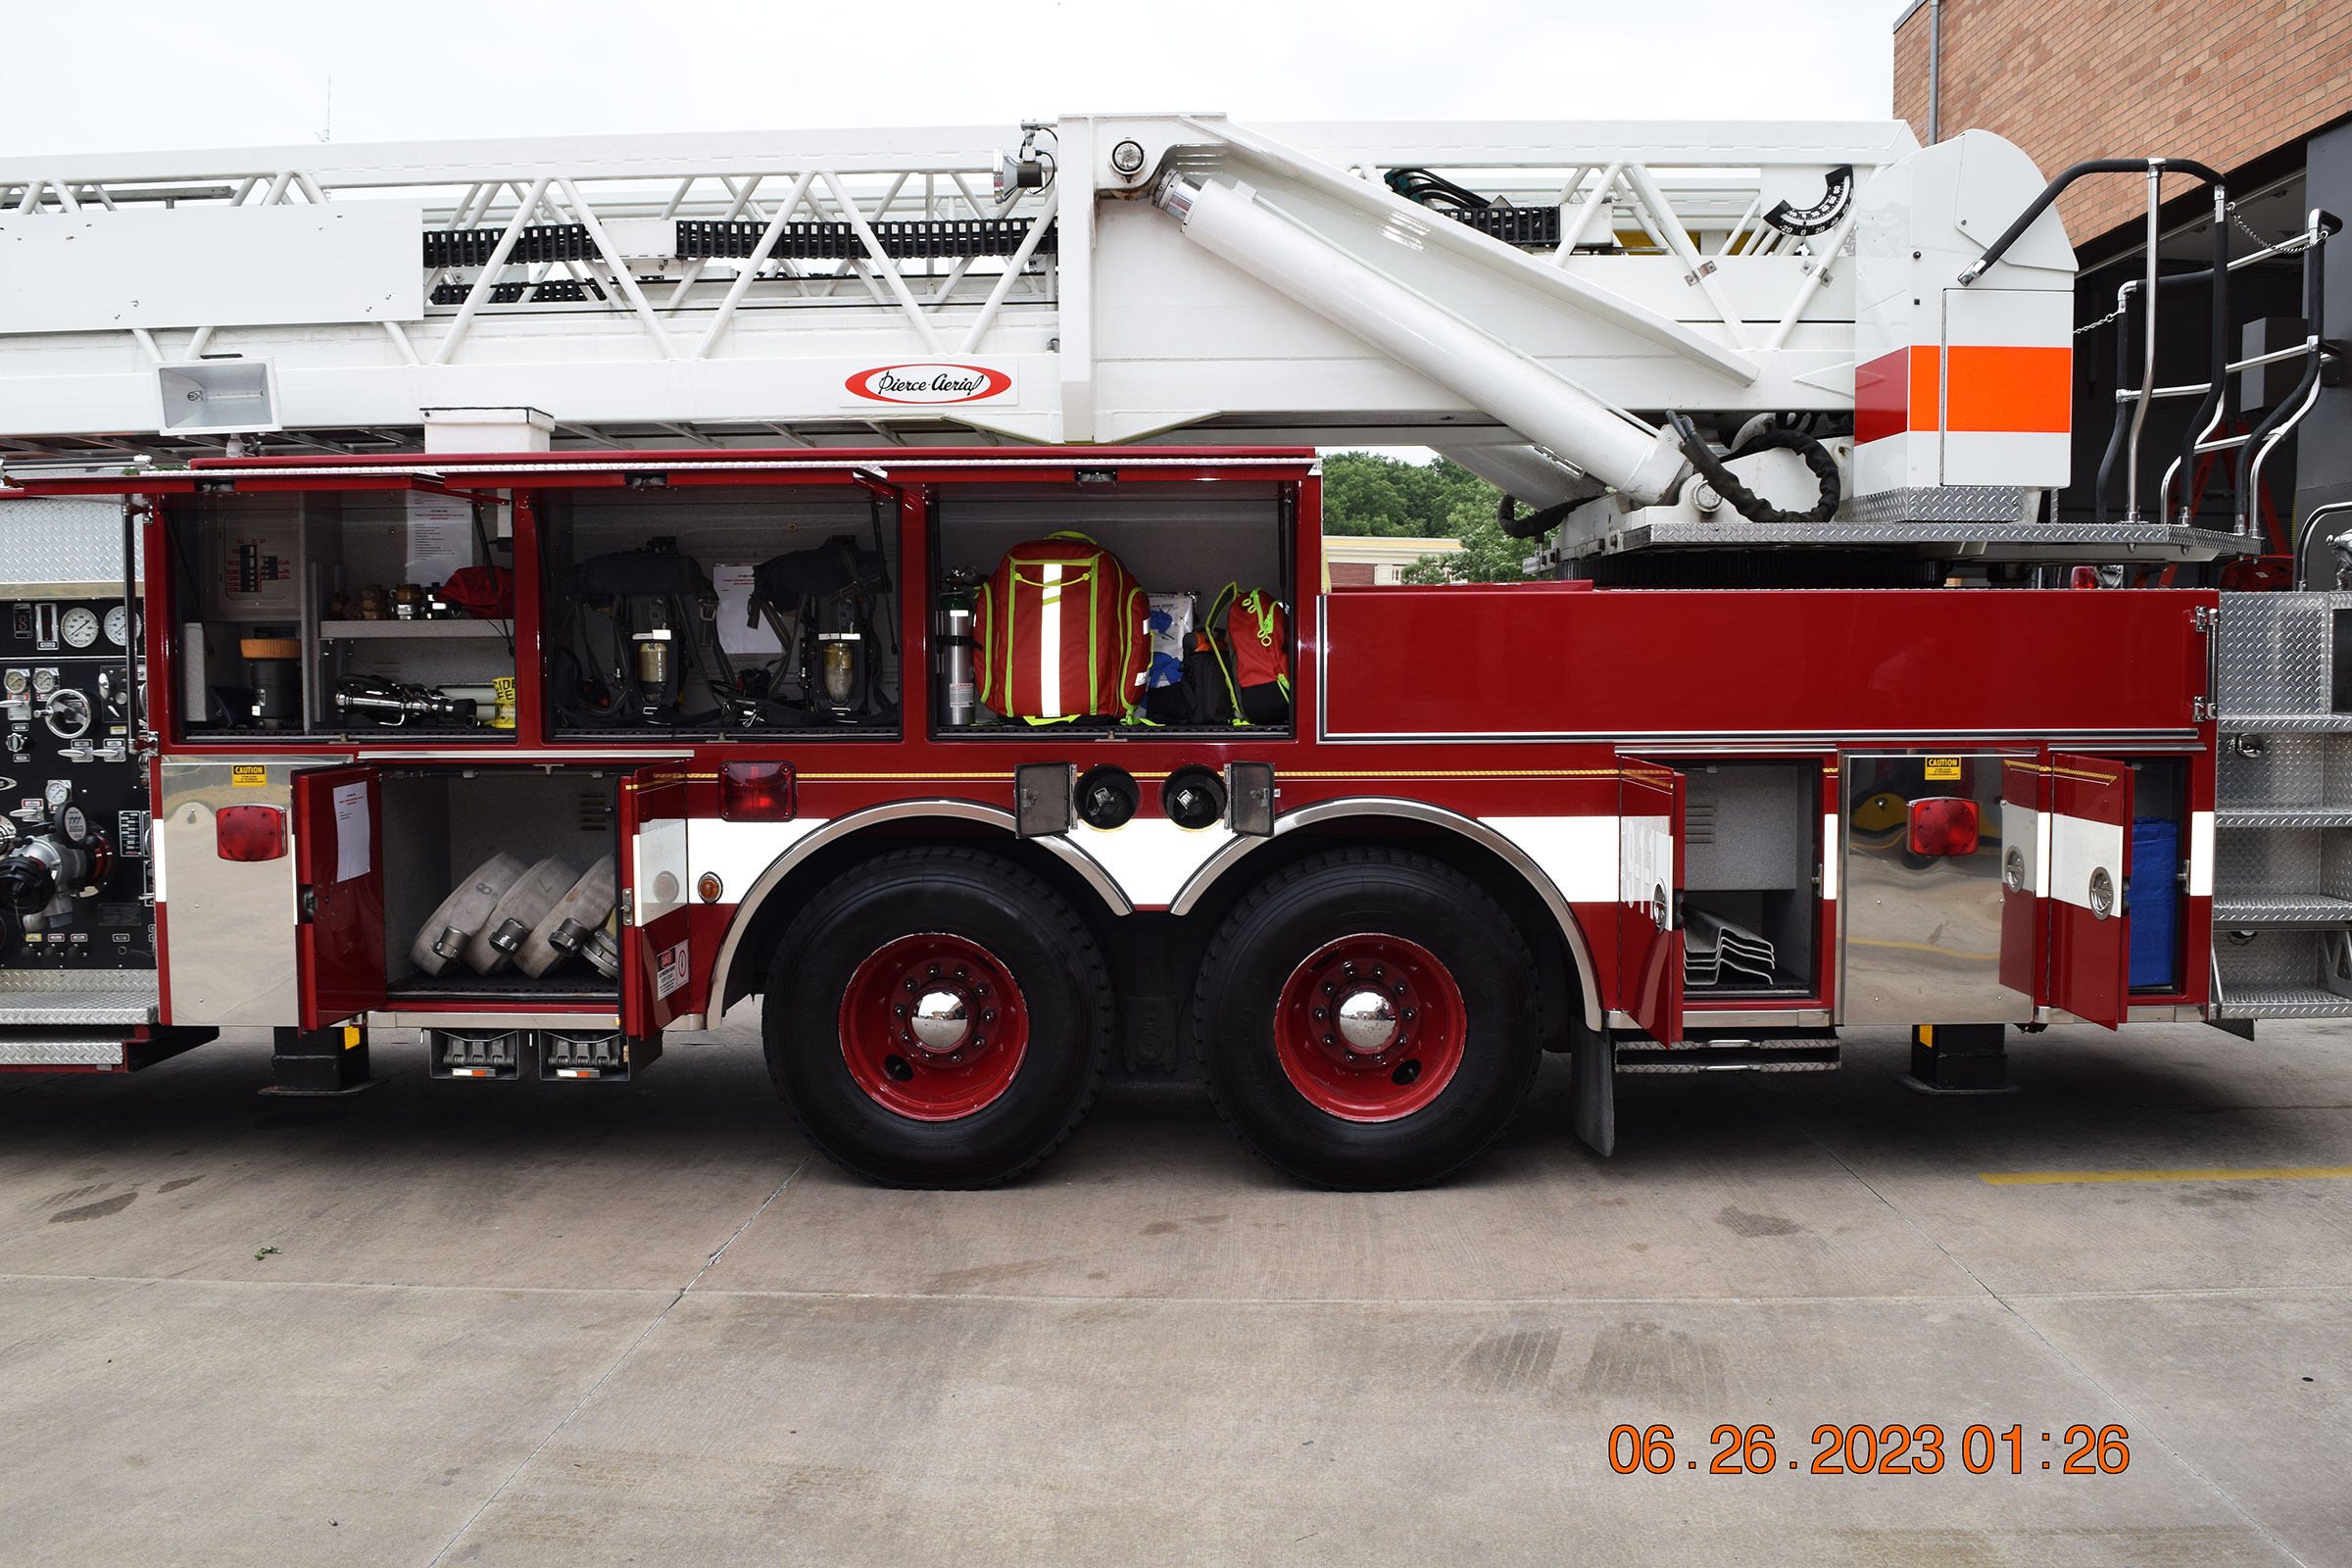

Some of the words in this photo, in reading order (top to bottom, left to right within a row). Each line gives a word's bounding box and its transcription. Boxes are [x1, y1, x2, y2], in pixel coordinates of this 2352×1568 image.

[1779, 224, 1793, 233] -20
[878, 370, 927, 395] Pierce
[930, 373, 985, 397] Aerial
